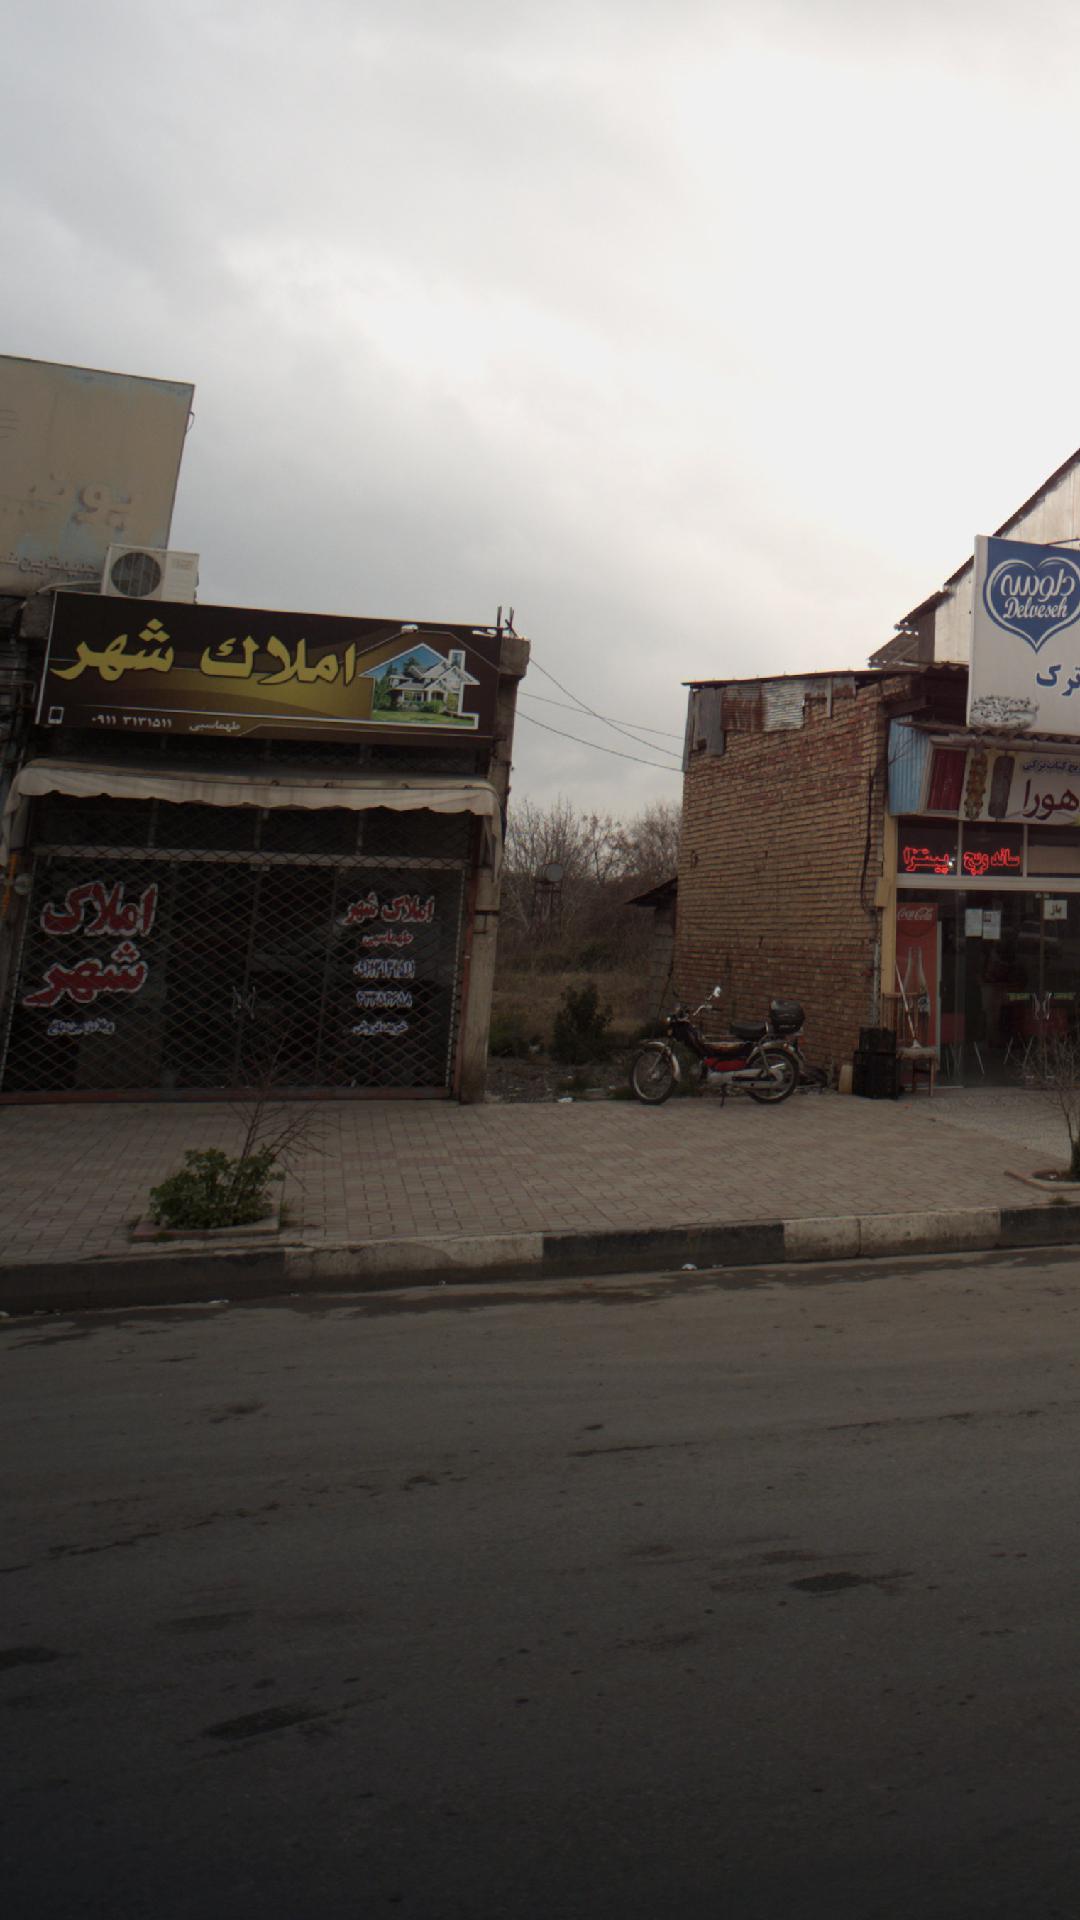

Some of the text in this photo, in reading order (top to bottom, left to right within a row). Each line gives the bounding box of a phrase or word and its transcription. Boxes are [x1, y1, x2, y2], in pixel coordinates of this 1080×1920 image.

[1001, 568, 1075, 602] دلوسه
[1003, 596, 1067, 618] Delveseh
[50, 618, 174, 681] شهر
[40, 880, 158, 937] املاک
[342, 891, 435, 926] املاک شهر
[22, 940, 149, 1007] شهر
